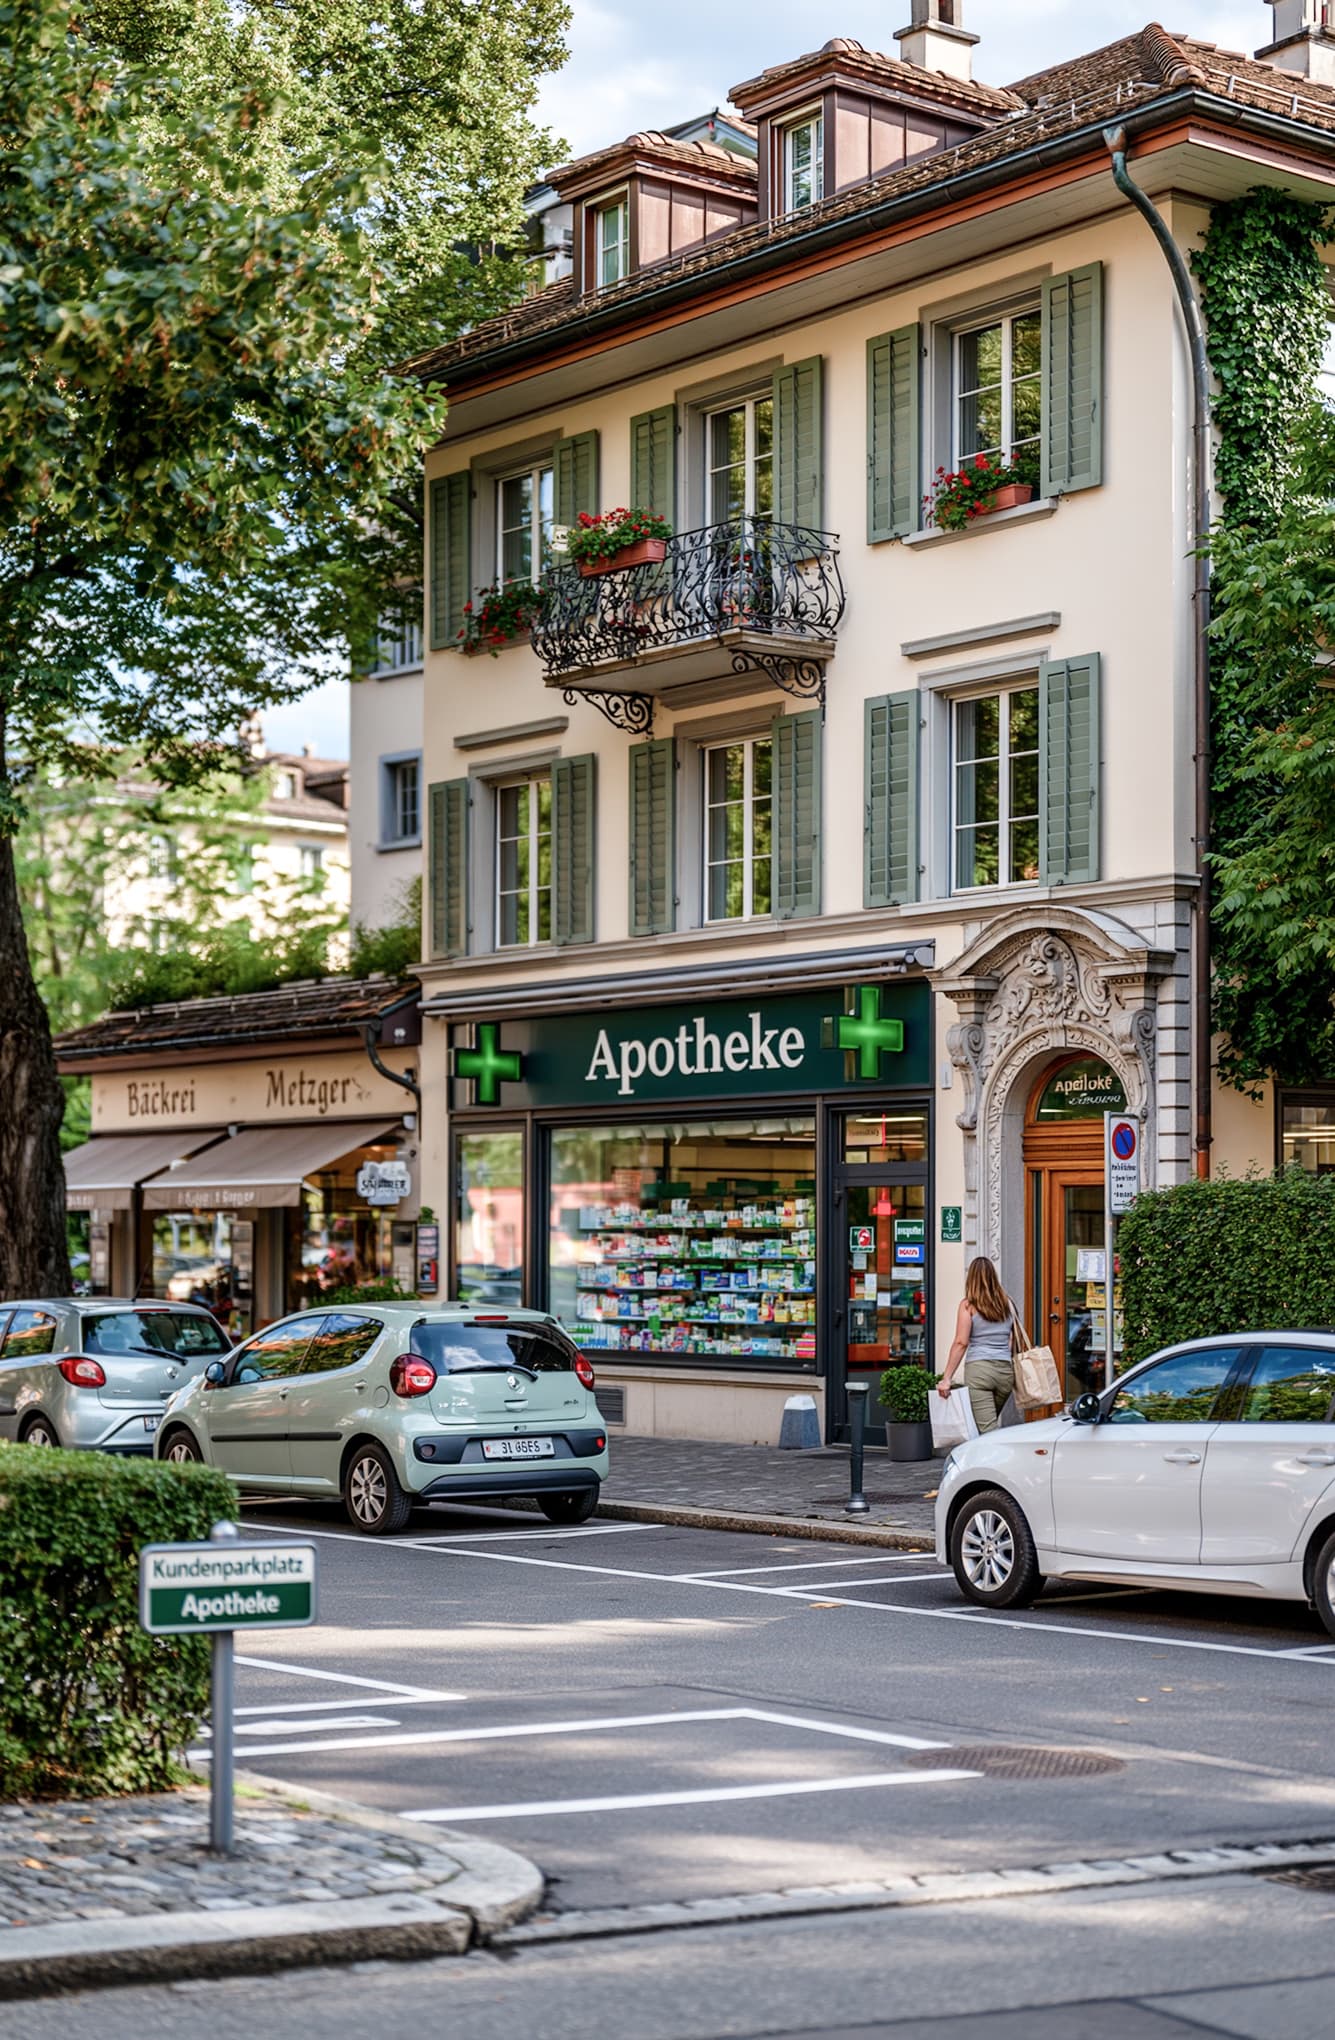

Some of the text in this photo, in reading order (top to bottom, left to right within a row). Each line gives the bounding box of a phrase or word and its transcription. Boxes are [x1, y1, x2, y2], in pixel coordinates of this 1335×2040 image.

[585, 1011, 805, 1095] Apotheke
[266, 1069, 351, 1114] Metzger
[153, 1555, 304, 1581] Kundenparkplatz
[181, 1590, 281, 1621] Apotheke
